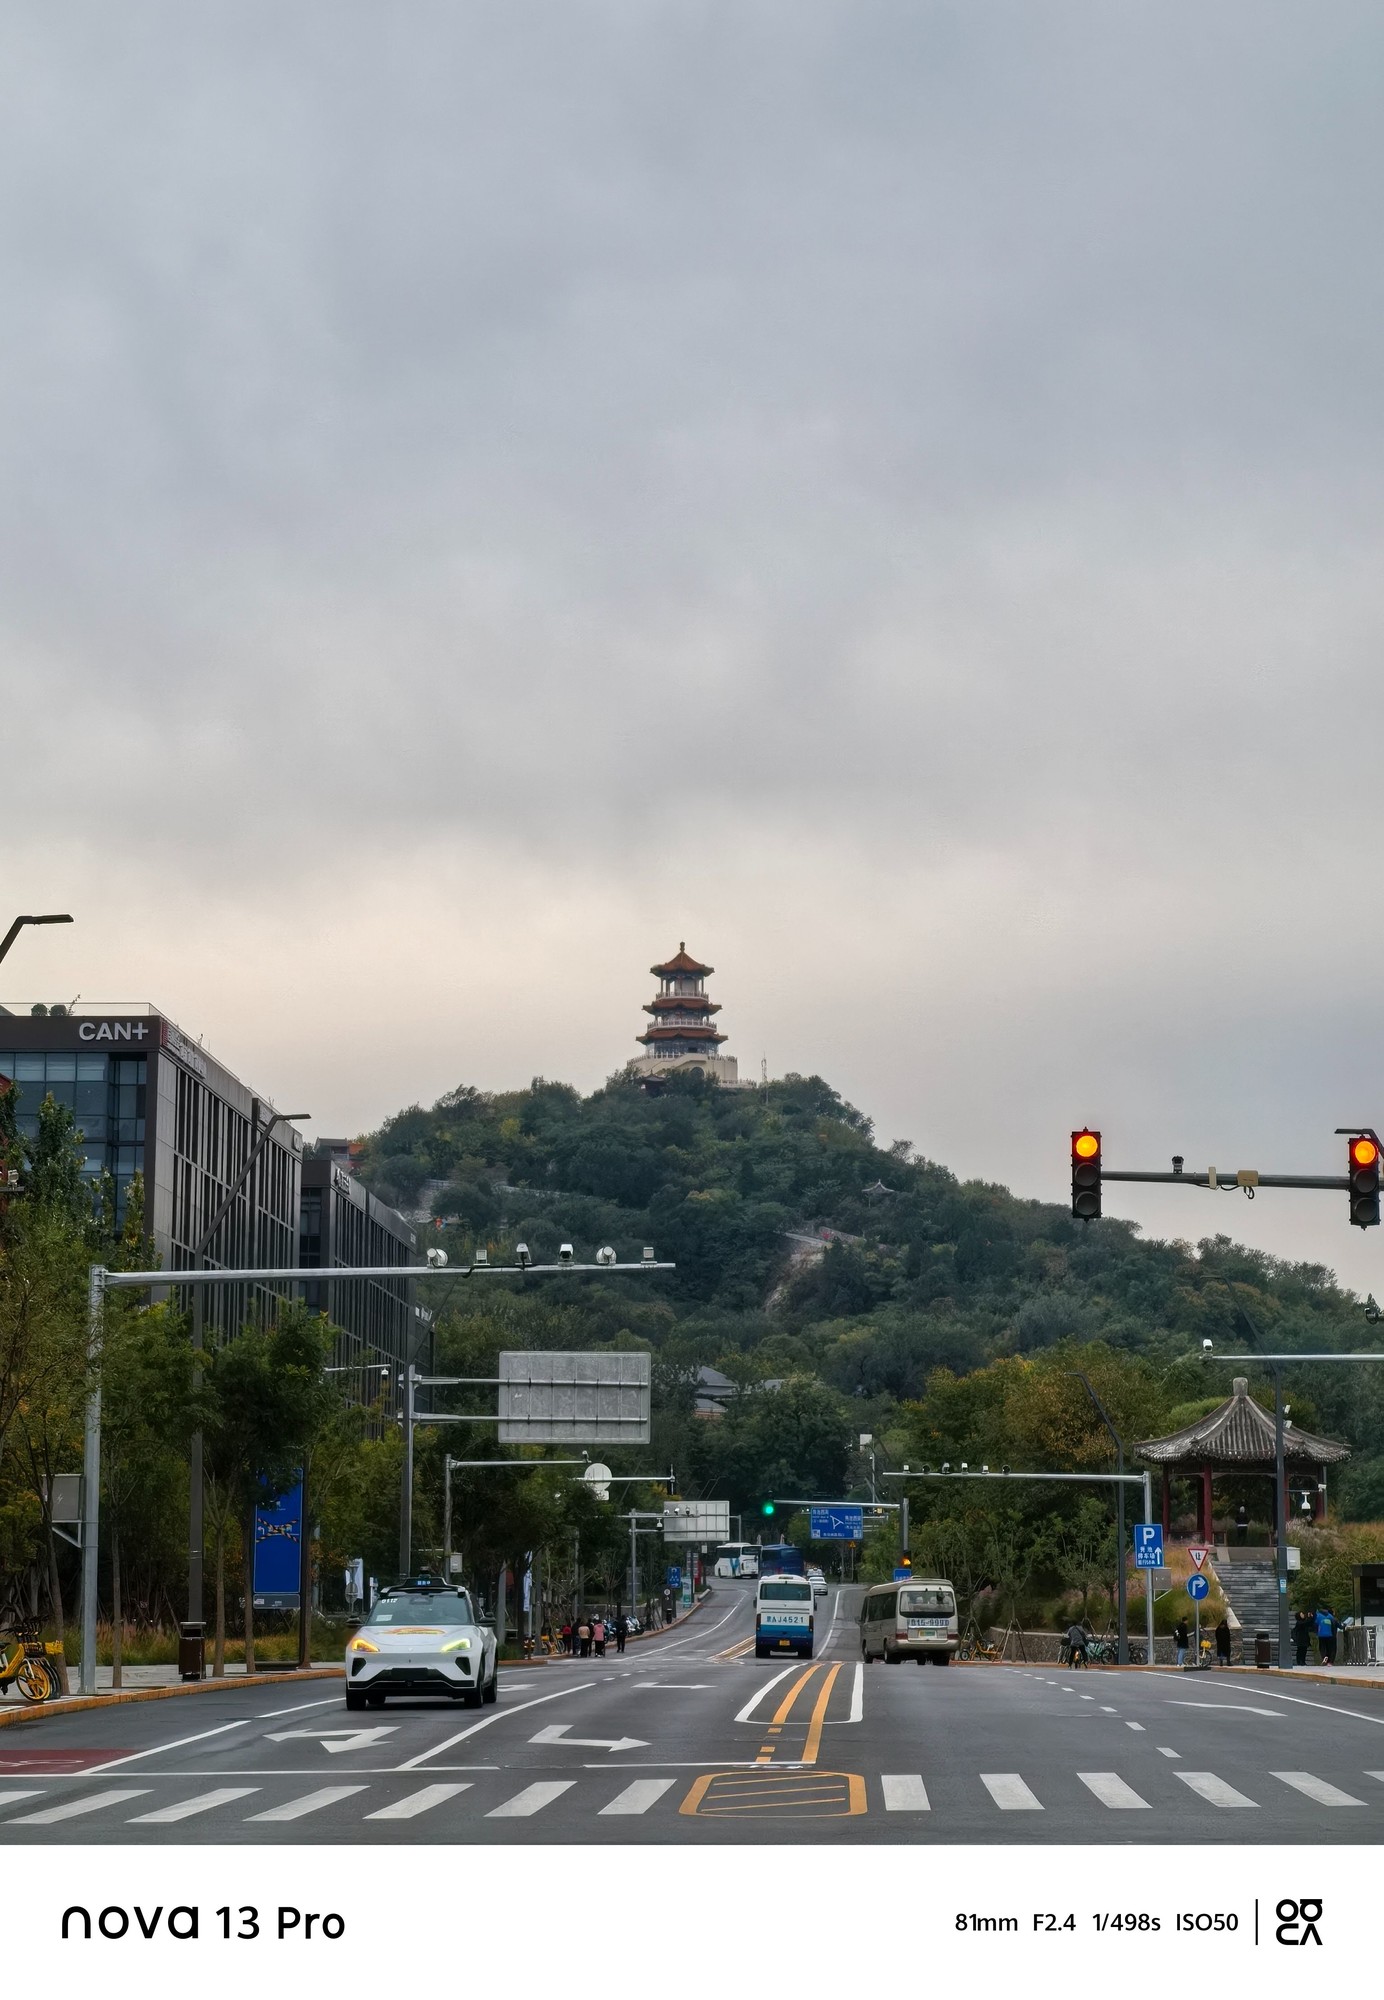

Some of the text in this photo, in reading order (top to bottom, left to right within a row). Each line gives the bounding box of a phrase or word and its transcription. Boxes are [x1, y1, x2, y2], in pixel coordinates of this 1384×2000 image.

[78, 1022, 149, 1041] CAN+
[1142, 1527, 1155, 1545] P
[1137, 1552, 1156, 1560] 停车场
[1195, 1552, 1202, 1561] 让
